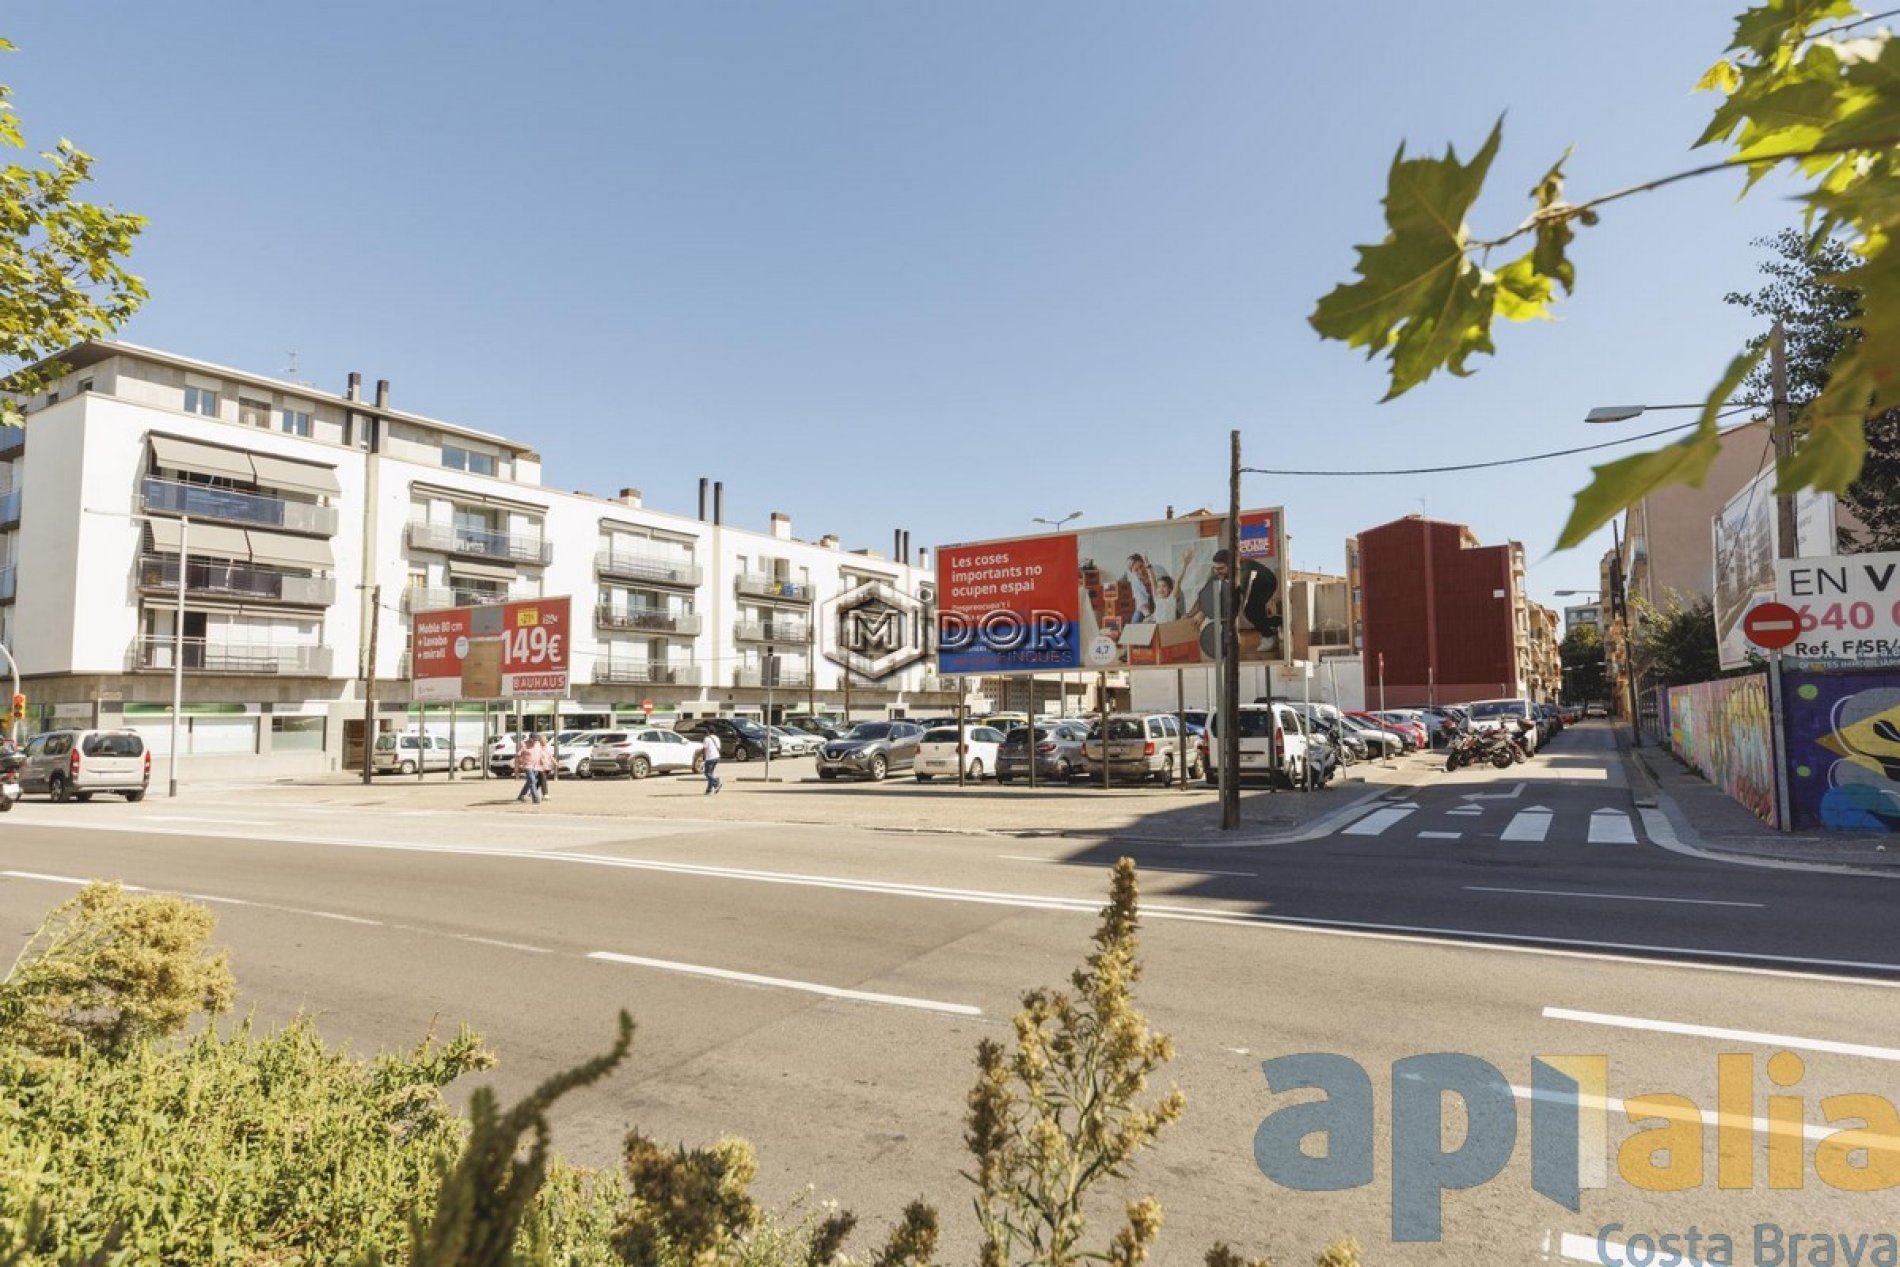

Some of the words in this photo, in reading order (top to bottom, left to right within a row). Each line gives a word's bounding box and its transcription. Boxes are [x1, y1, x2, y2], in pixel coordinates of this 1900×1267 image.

[952, 556, 972, 568] Les
[974, 553, 1010, 566] coses
[952, 566, 1022, 584] importants
[1025, 564, 1043, 576] no
[1790, 567, 1848, 596] EN
[951, 583, 998, 599] ocupen
[1000, 578, 1035, 597] espai
[1799, 601, 1875, 633] 640
[502, 626, 562, 665] 149€
[513, 675, 565, 690] BAUHAUS
